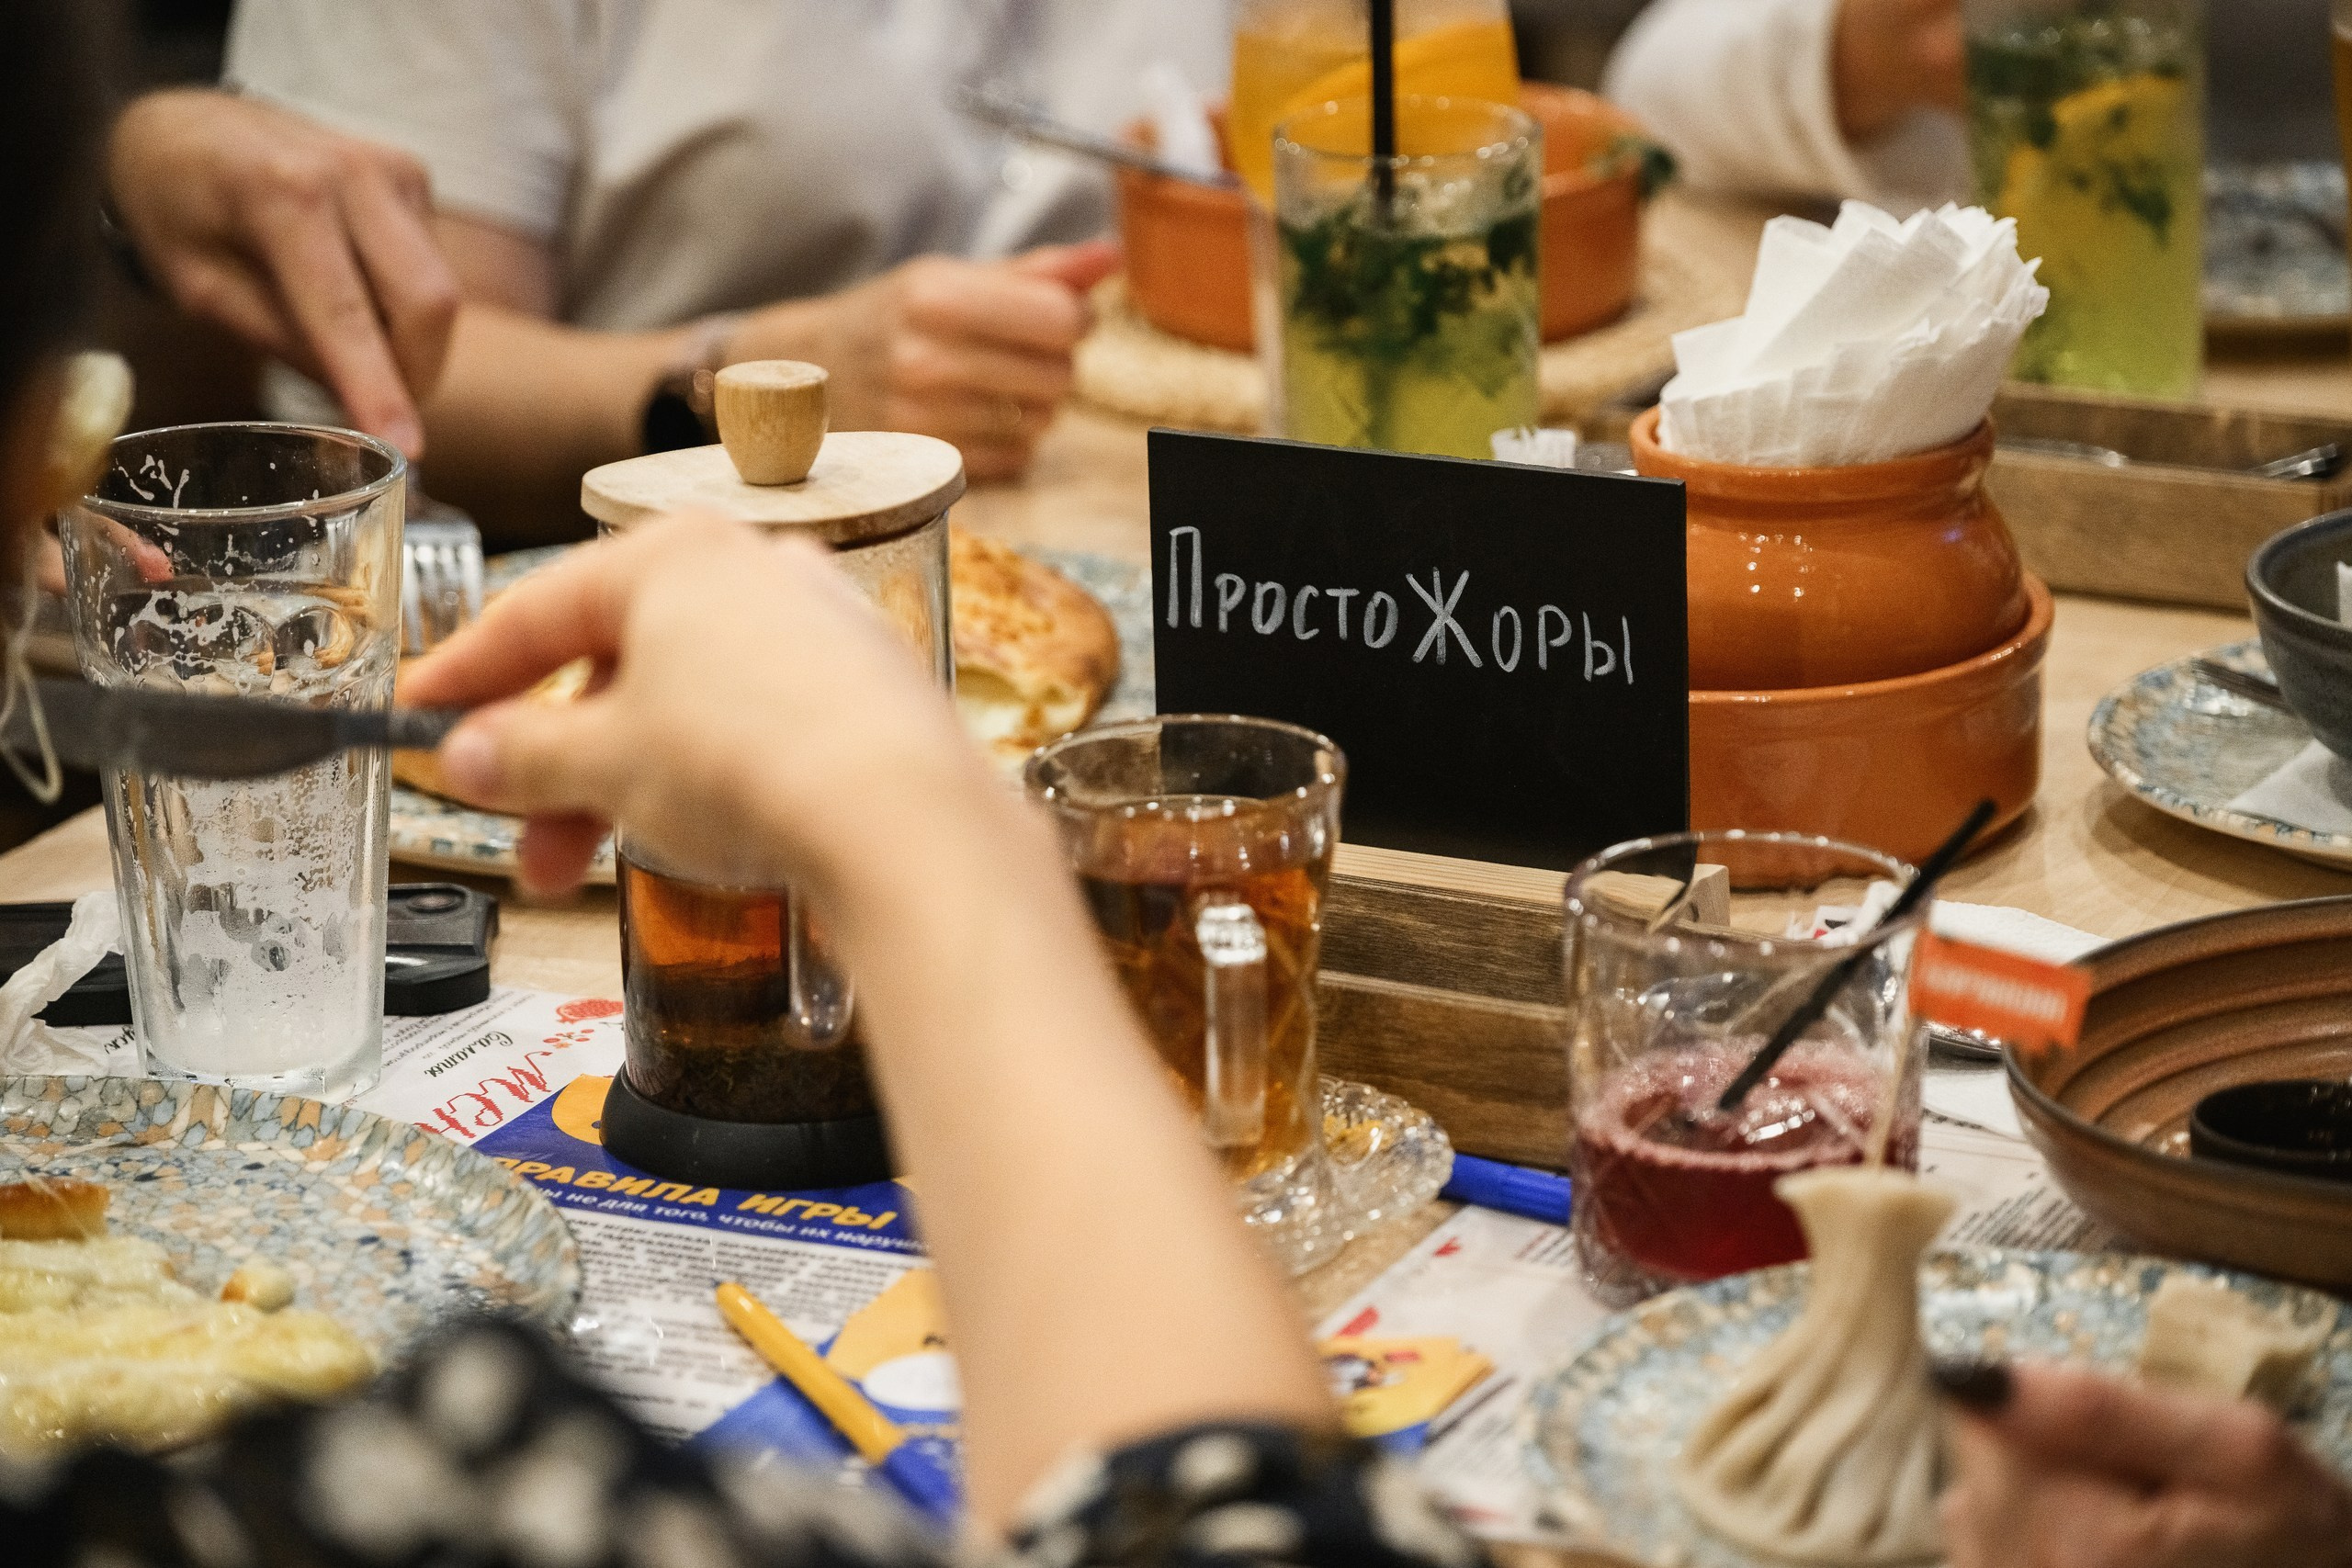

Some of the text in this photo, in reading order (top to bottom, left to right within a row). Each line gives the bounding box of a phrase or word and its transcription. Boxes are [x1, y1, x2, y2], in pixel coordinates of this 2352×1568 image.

[424, 1030, 514, 1077] Салаты
[413, 1051, 553, 1138] Мен
[566, 1193, 597, 1204] не
[597, 1199, 649, 1212] для
[654, 1205, 709, 1222] того,
[718, 1214, 796, 1233] чтобы
[799, 1227, 831, 1239] их
[737, 1193, 898, 1229] ИГРЫ
